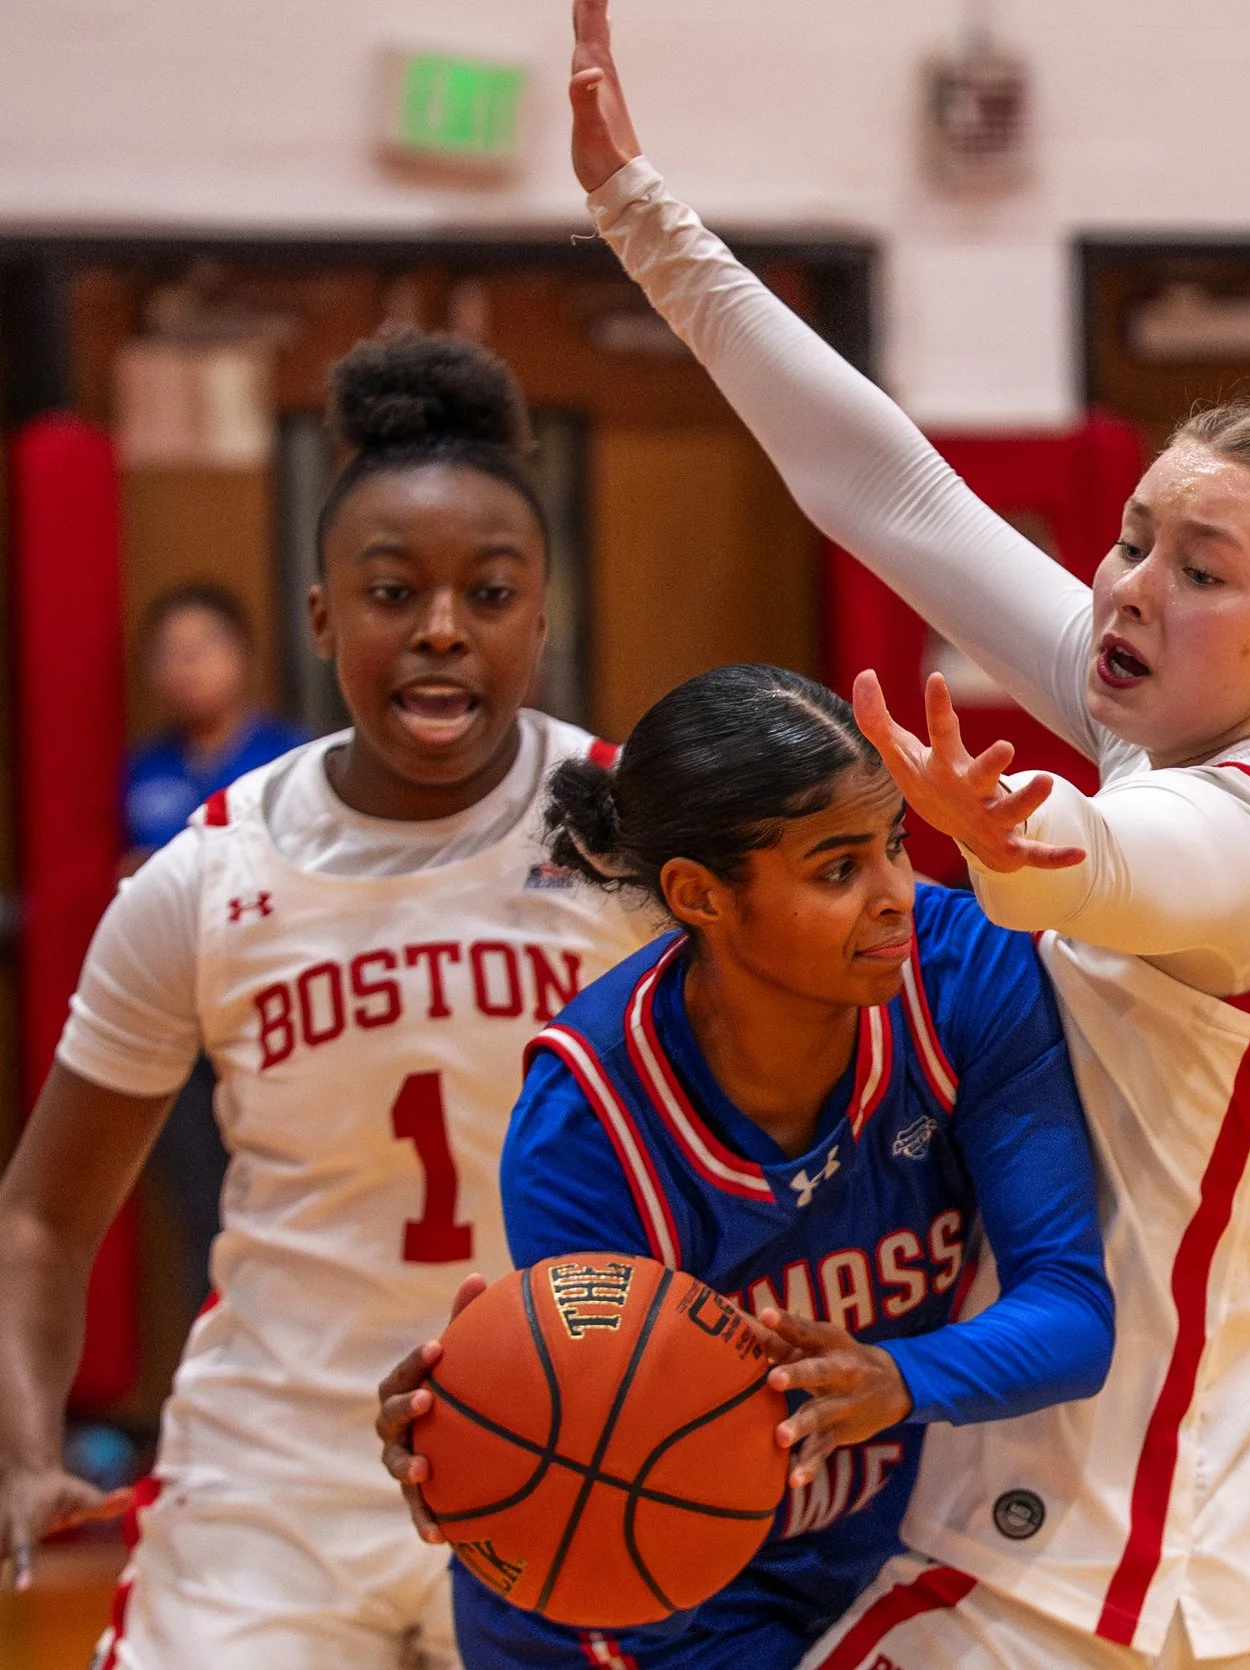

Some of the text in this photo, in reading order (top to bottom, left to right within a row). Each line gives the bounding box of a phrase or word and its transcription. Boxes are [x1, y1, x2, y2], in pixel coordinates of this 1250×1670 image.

[254, 939, 582, 1073] BOSTON
[390, 1070, 473, 1264] 1
[548, 1263, 634, 1339] THE
[723, 1208, 967, 1333] MASS
